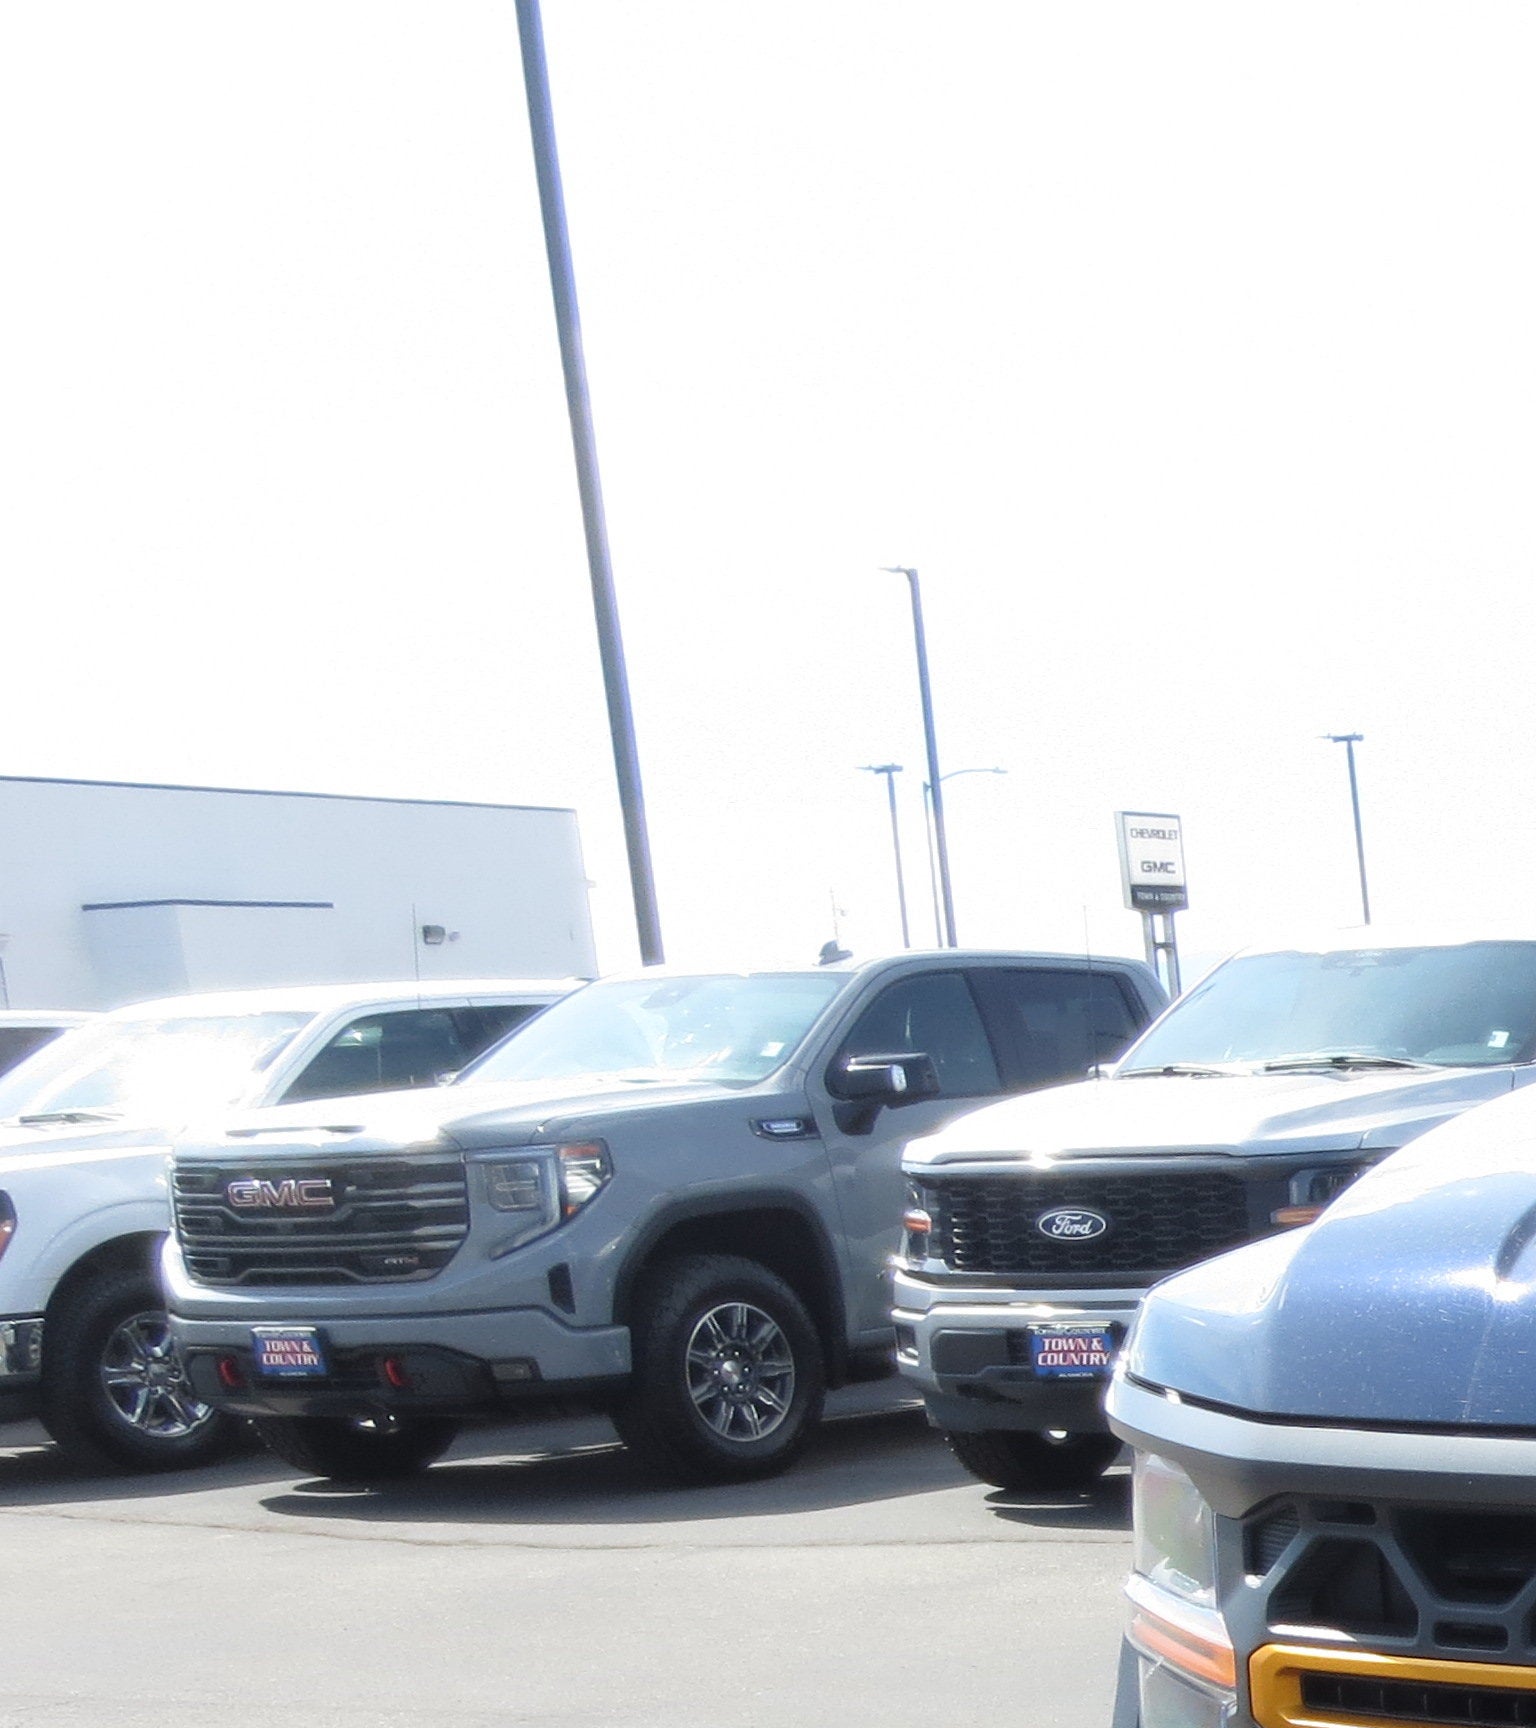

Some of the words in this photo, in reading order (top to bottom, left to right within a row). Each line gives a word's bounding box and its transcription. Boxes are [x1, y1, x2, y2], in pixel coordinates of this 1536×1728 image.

[1130, 828, 1178, 840] CHEVROLET
[1140, 860, 1176, 874] GMC
[228, 1179, 334, 1207] GMC
[1052, 1214, 1093, 1235] Ford
[264, 1340, 300, 1353] TOWN
[302, 1340, 312, 1353] &
[1042, 1337, 1089, 1351] TOWN
[1091, 1337, 1104, 1351] &
[261, 1352, 320, 1366] COUNTRY
[1037, 1351, 1110, 1366] COUNTRY
